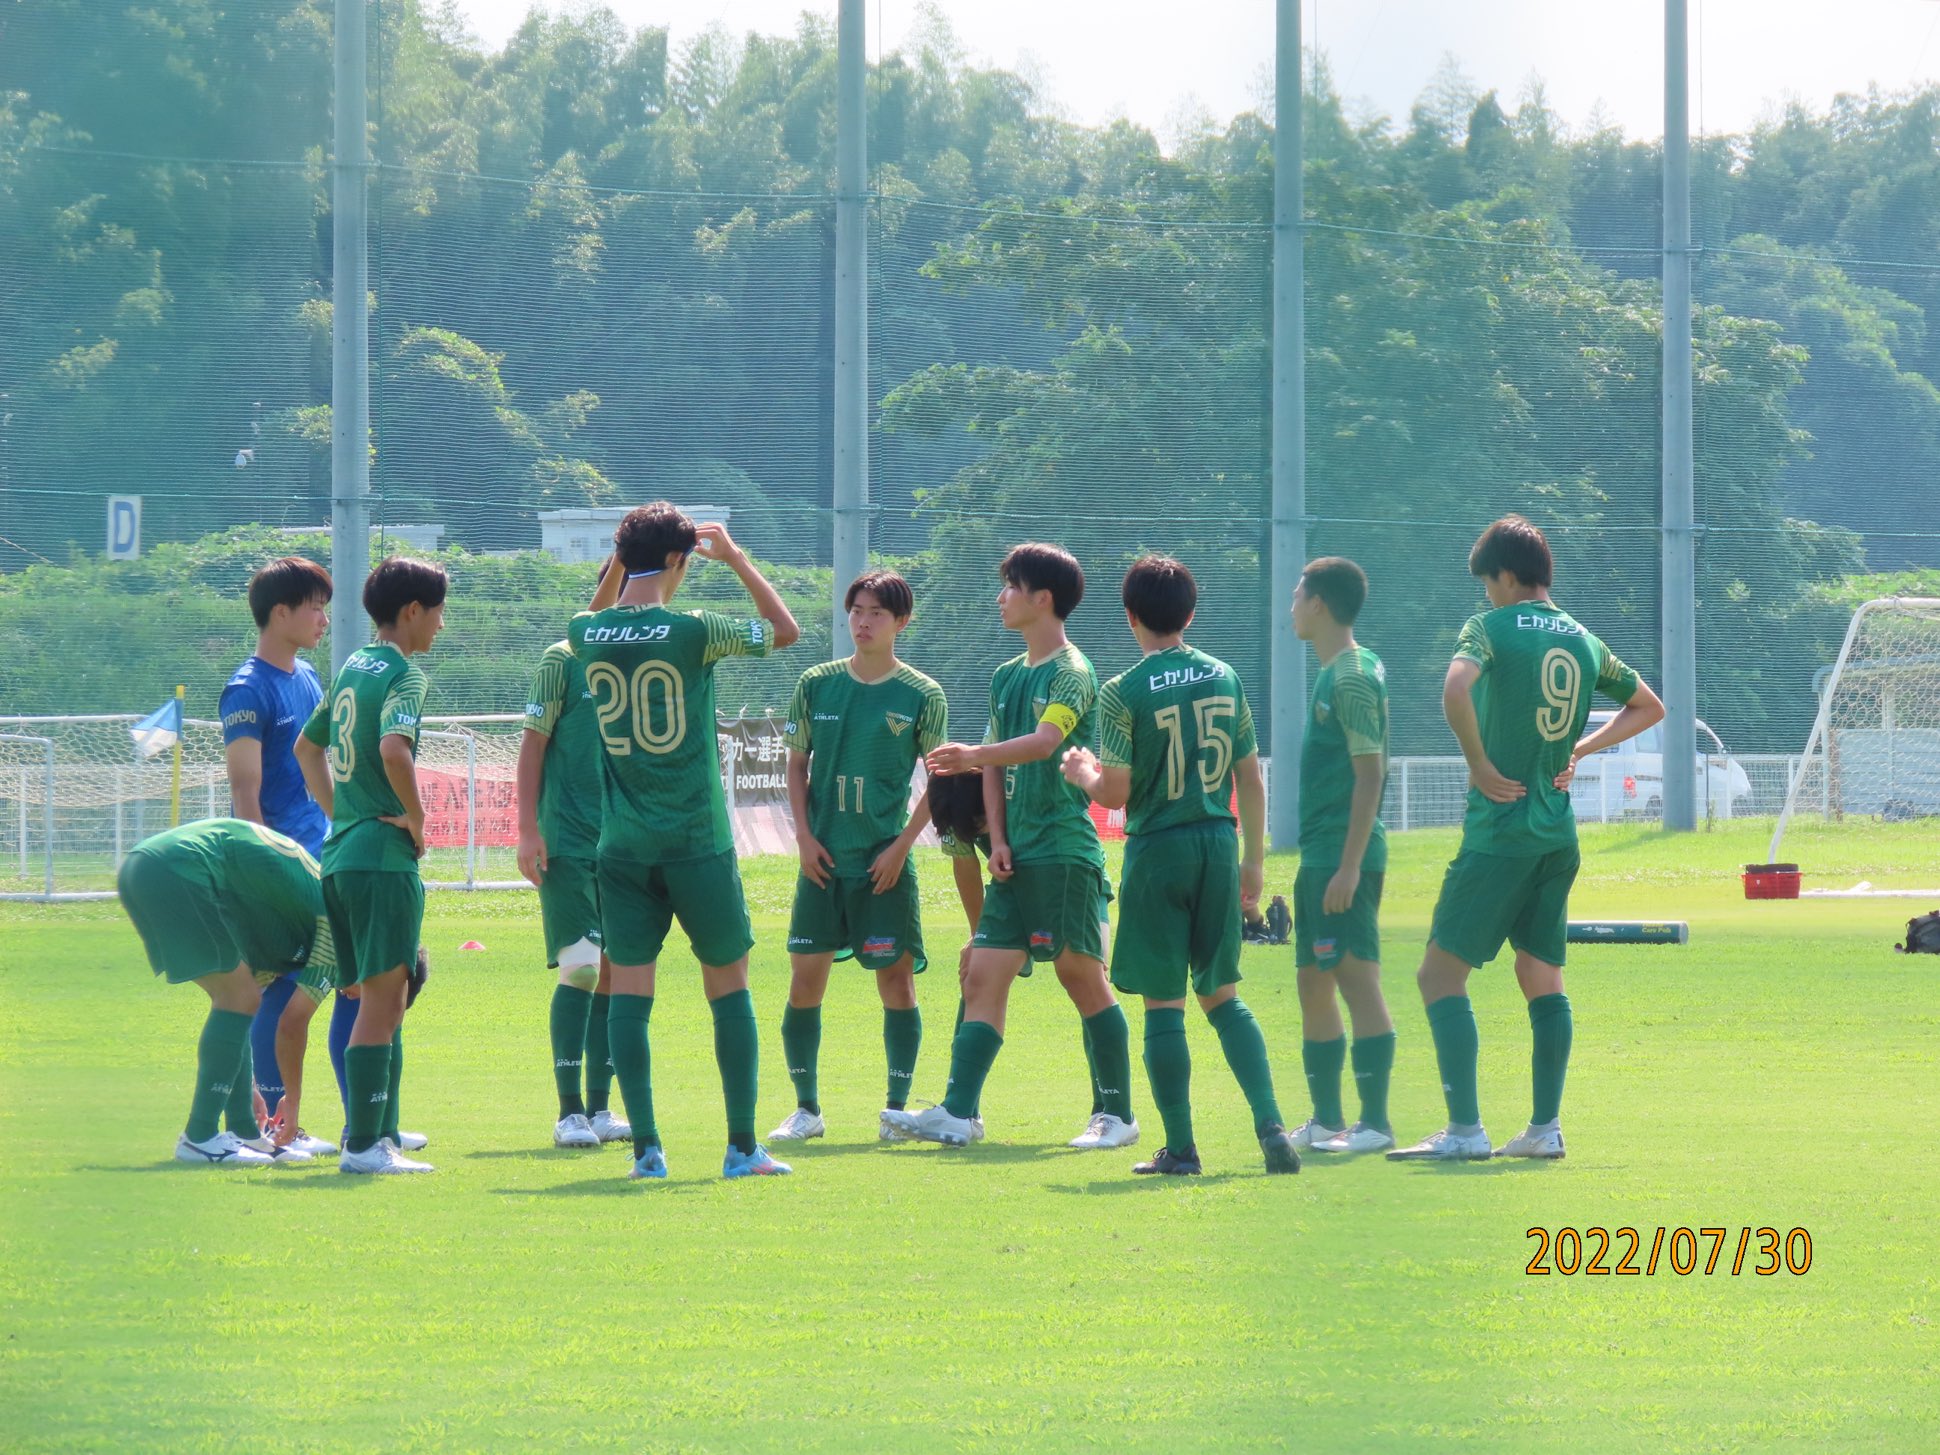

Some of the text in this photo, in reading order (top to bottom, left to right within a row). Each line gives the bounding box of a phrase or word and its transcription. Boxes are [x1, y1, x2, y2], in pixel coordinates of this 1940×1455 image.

[113, 501, 136, 553] D
[583, 625, 671, 642] ヒカリレンタ
[1149, 664, 1226, 691] ヒカリレンタ
[1536, 647, 1581, 741] 9
[223, 709, 257, 728] TOKYO
[585, 659, 687, 756] 20
[332, 687, 356, 783] 3
[1154, 695, 1235, 800] 15
[736, 773, 788, 790] FOOTBALL
[837, 775, 864, 813] 11
